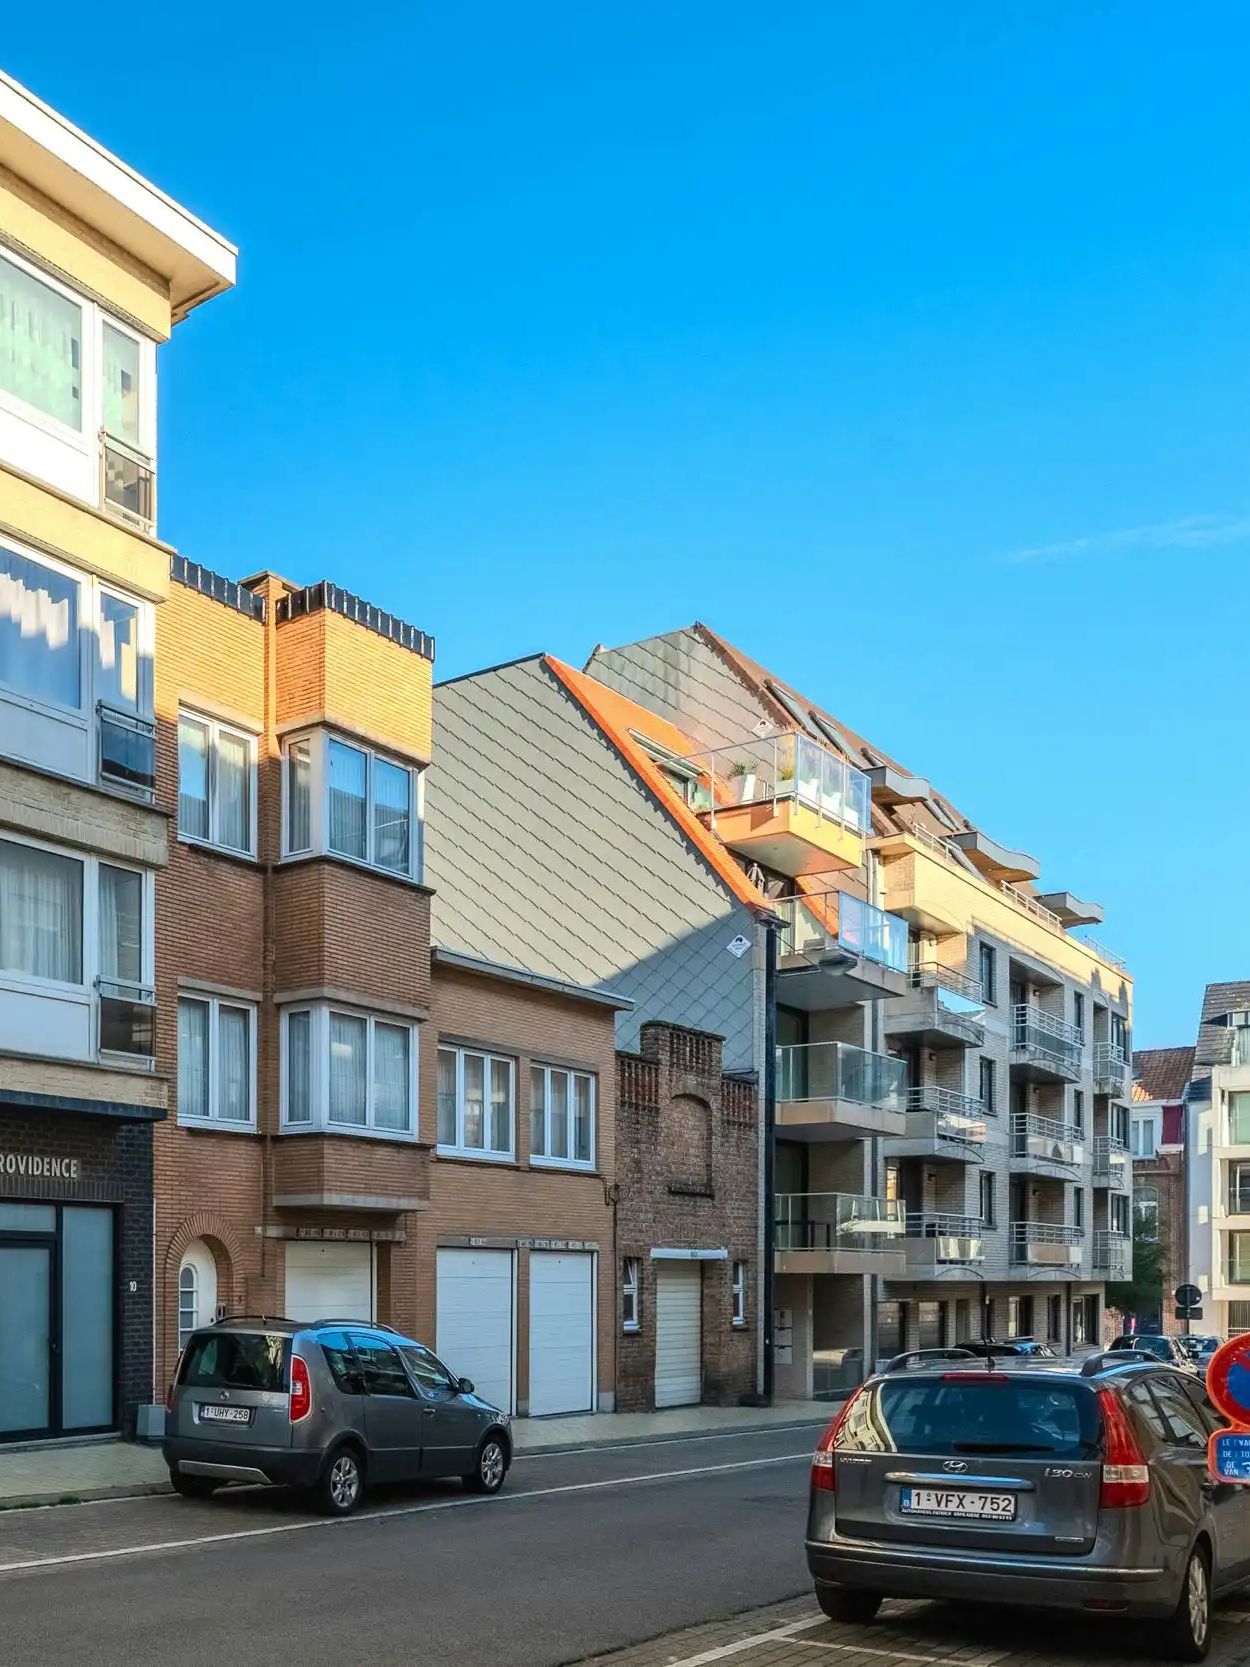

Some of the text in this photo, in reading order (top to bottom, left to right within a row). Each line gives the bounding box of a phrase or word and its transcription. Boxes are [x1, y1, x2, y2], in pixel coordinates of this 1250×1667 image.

[129, 1280, 137, 1292] 10
[1223, 1468, 1239, 1476] VAN
[914, 1492, 1012, 1513] 1-VFX-752
